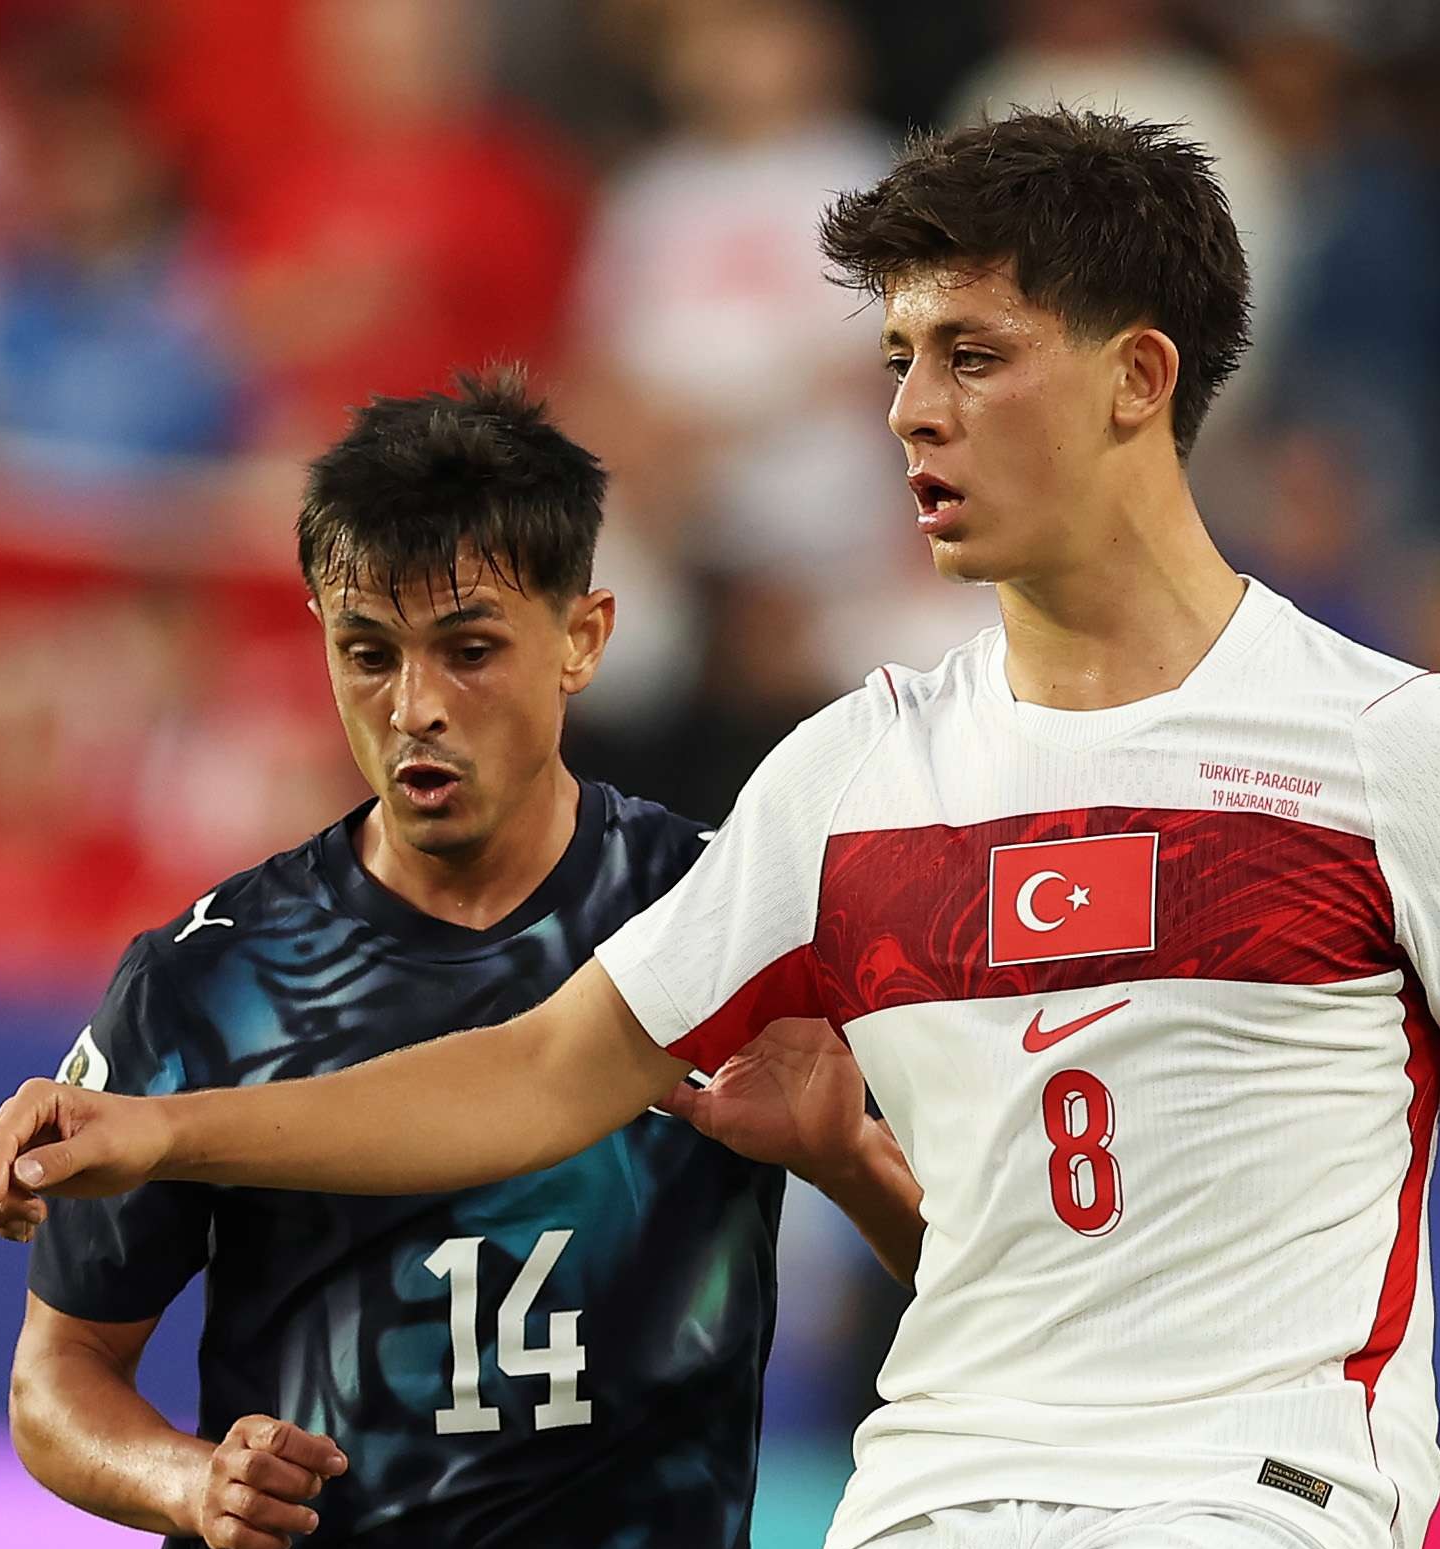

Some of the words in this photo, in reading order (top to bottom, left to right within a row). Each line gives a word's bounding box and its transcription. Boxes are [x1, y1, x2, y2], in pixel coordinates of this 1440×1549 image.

[1198, 761, 1322, 798] TÜRKİYE-PARAGUAY
[1212, 789, 1225, 807] 19
[1225, 790, 1273, 813] HAZİRAN
[1274, 798, 1300, 818] 2026
[1041, 1069, 1123, 1238] 8
[423, 1229, 592, 1435] 14
